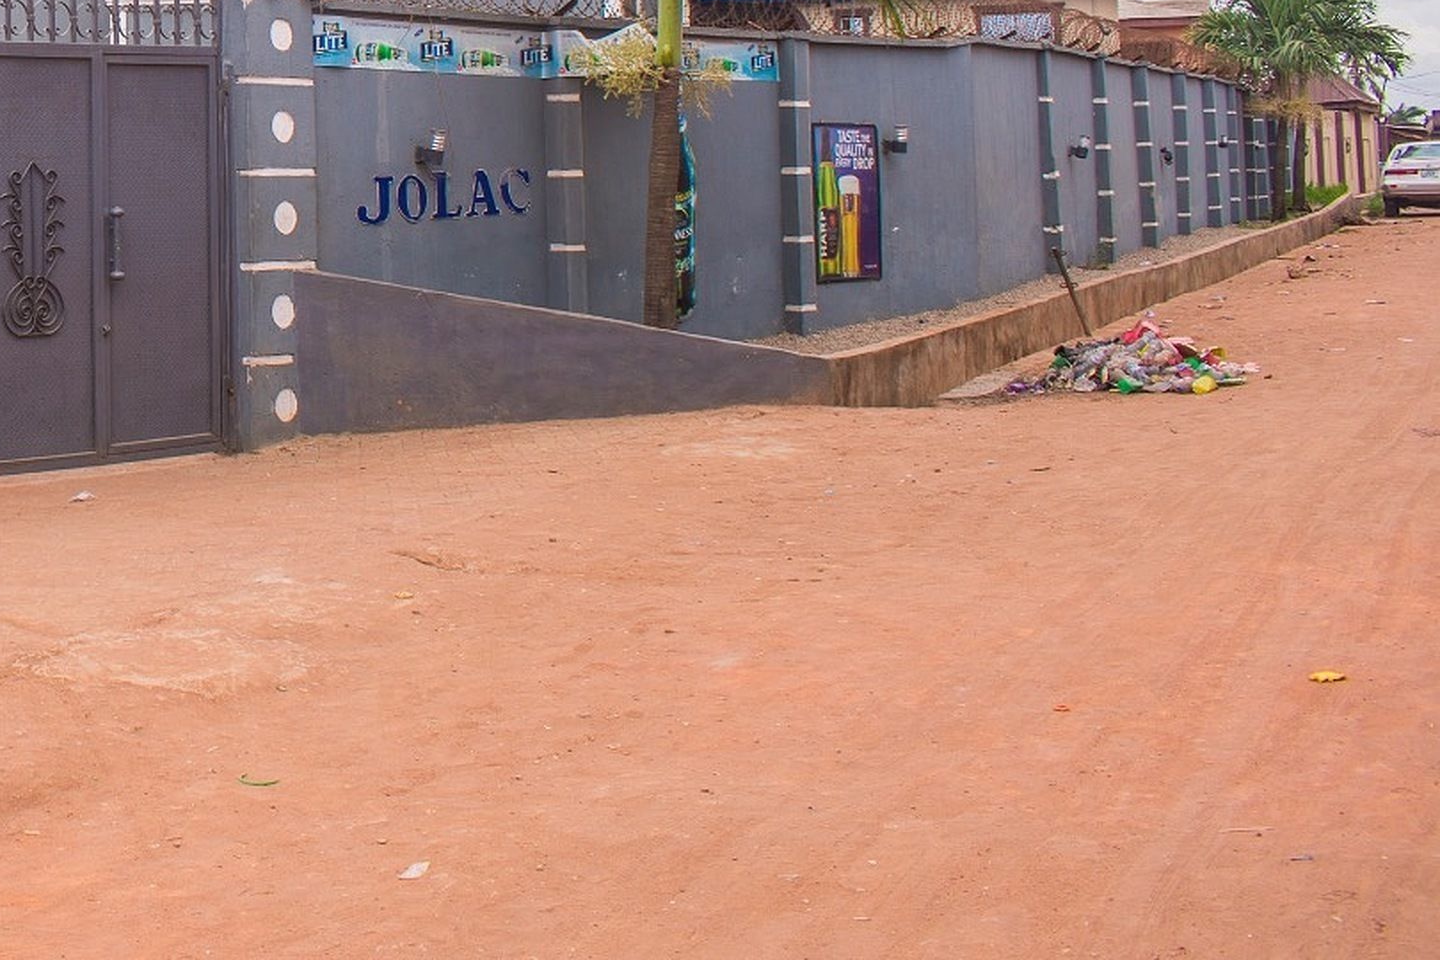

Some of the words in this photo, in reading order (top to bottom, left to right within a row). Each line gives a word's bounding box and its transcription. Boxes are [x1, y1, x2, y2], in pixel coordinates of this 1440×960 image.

[315, 33, 345, 54] LITE
[423, 41, 450, 60] LITE
[523, 47, 549, 64] LITE
[837, 129, 860, 143] TASTE
[835, 143, 867, 158] QUALITY
[852, 157, 875, 170] DROP
[357, 168, 532, 226] JOLAC
[820, 210, 828, 258] HARP
